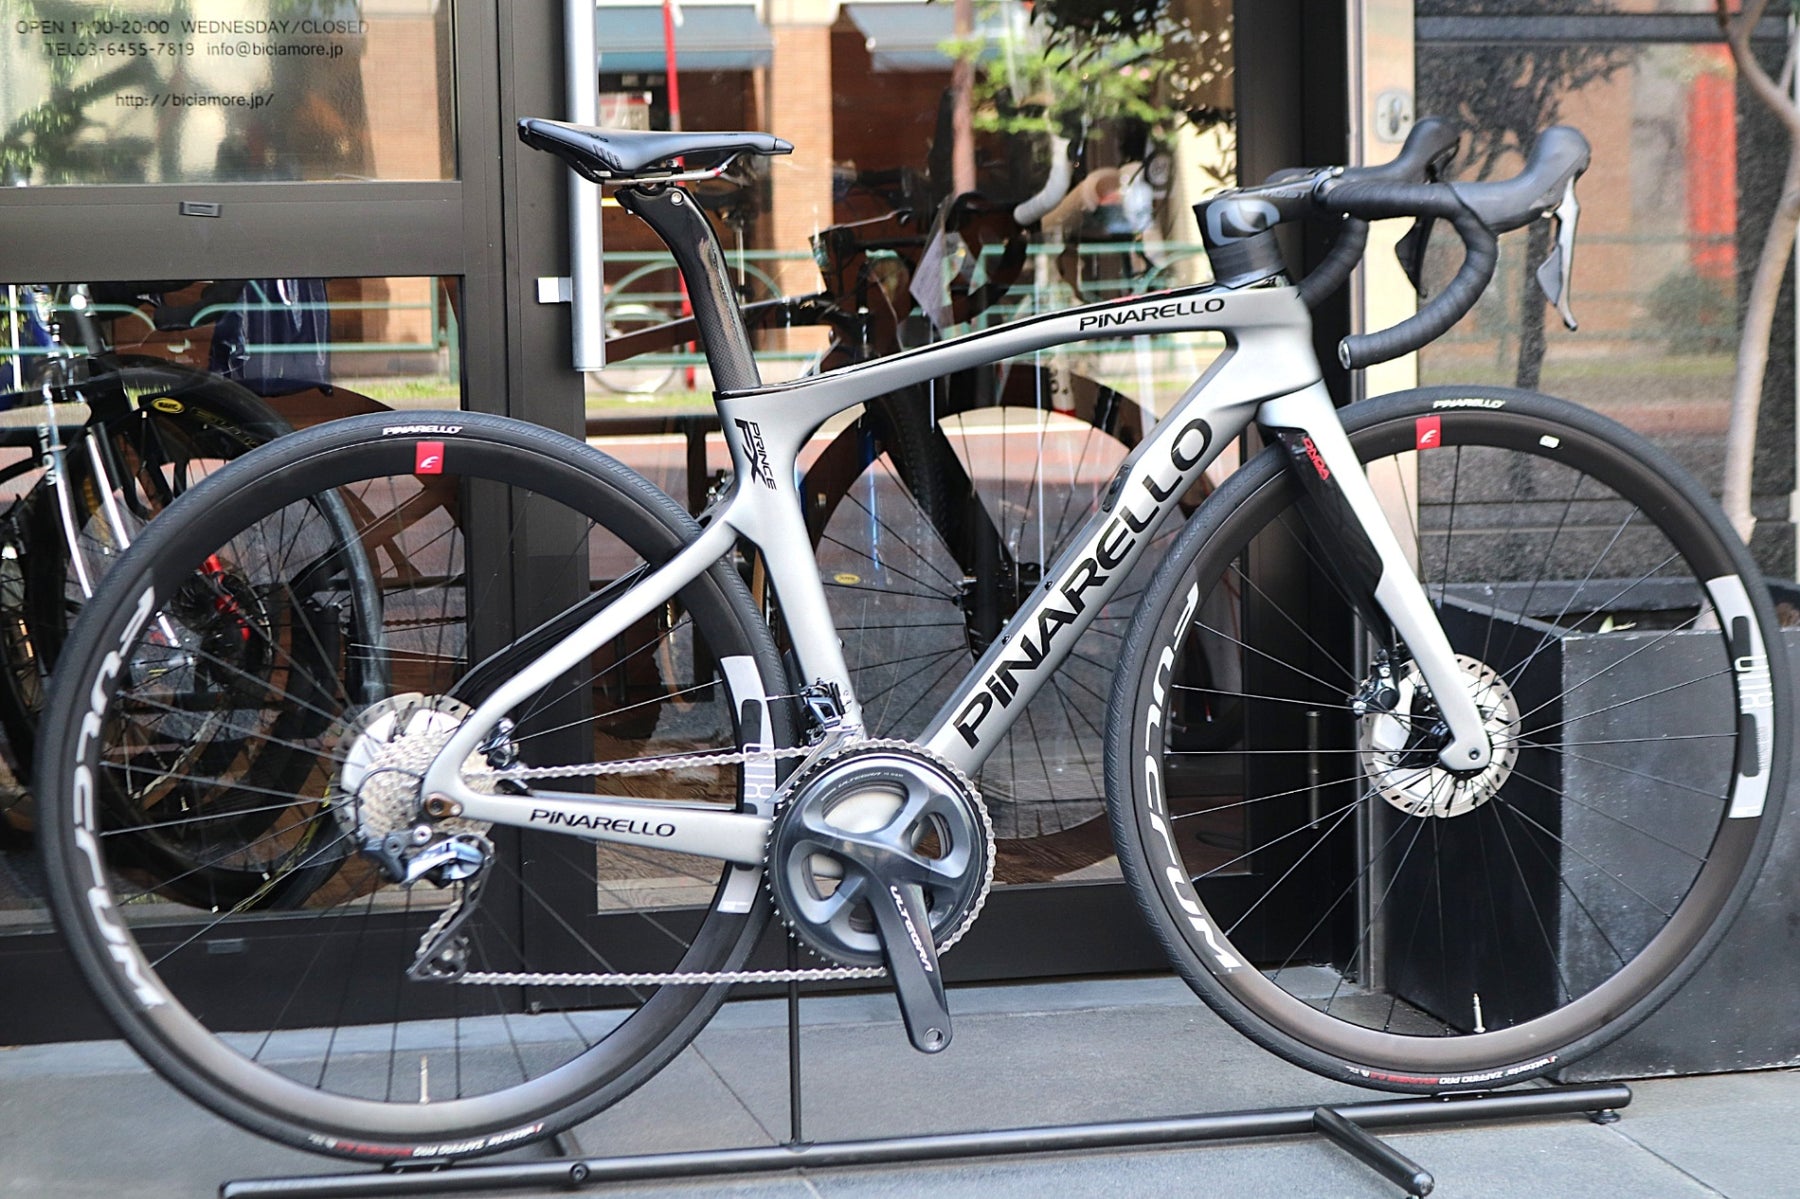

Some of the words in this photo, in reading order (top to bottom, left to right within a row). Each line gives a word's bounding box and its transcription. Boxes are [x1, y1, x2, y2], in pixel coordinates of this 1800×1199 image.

[16, 20, 64, 34] OPEN
[181, 20, 369, 34] WEDNESDAY/CLOSED
[207, 41, 344, 58] info@biciamore.jp
[116, 92, 274, 109] http://biciamore.jp/
[1079, 298, 1225, 331] PINARELLO
[382, 424, 463, 436] PINARELLO
[749, 421, 777, 490] PRINCE
[1302, 436, 1331, 480] ONDA
[953, 417, 1214, 749] PINARELLO
[1143, 582, 1242, 975] FULCRUM
[529, 808, 677, 839] PINARELLO
[888, 884, 935, 974] ULTEGRA
[1438, 1075, 1461, 1086] PRO
